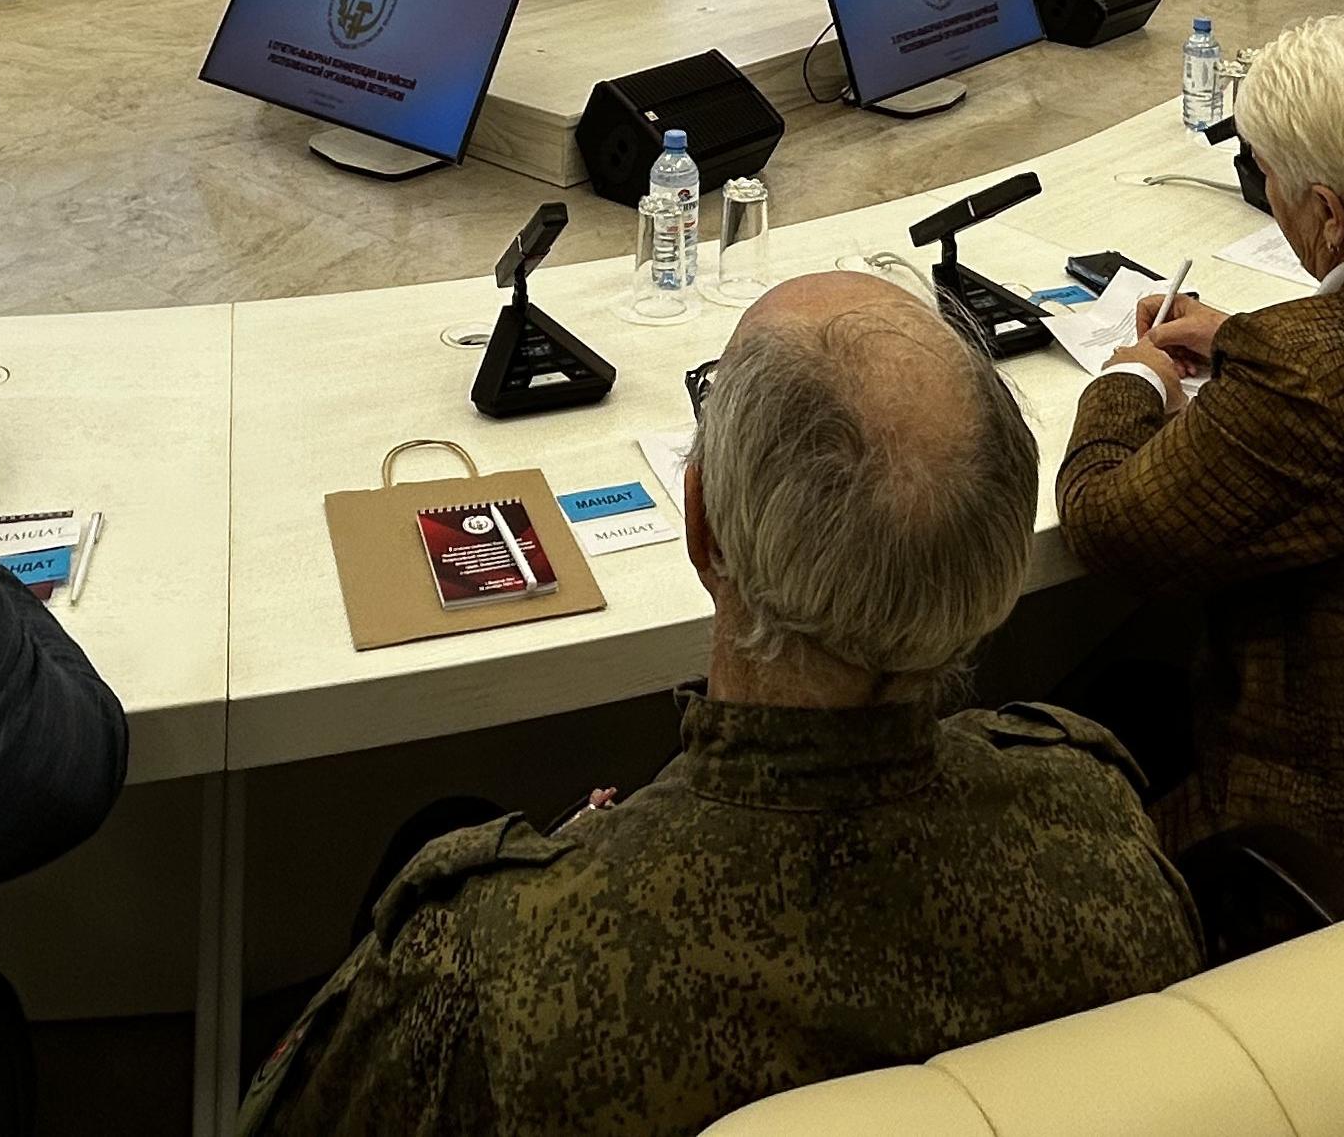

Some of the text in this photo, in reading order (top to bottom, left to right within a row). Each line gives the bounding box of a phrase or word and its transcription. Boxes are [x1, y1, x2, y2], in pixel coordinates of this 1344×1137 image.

[575, 490, 633, 509] МАНДАТ
[594, 523, 654, 540] МАНДАТ
[9, 558, 55, 574] НДАТ
